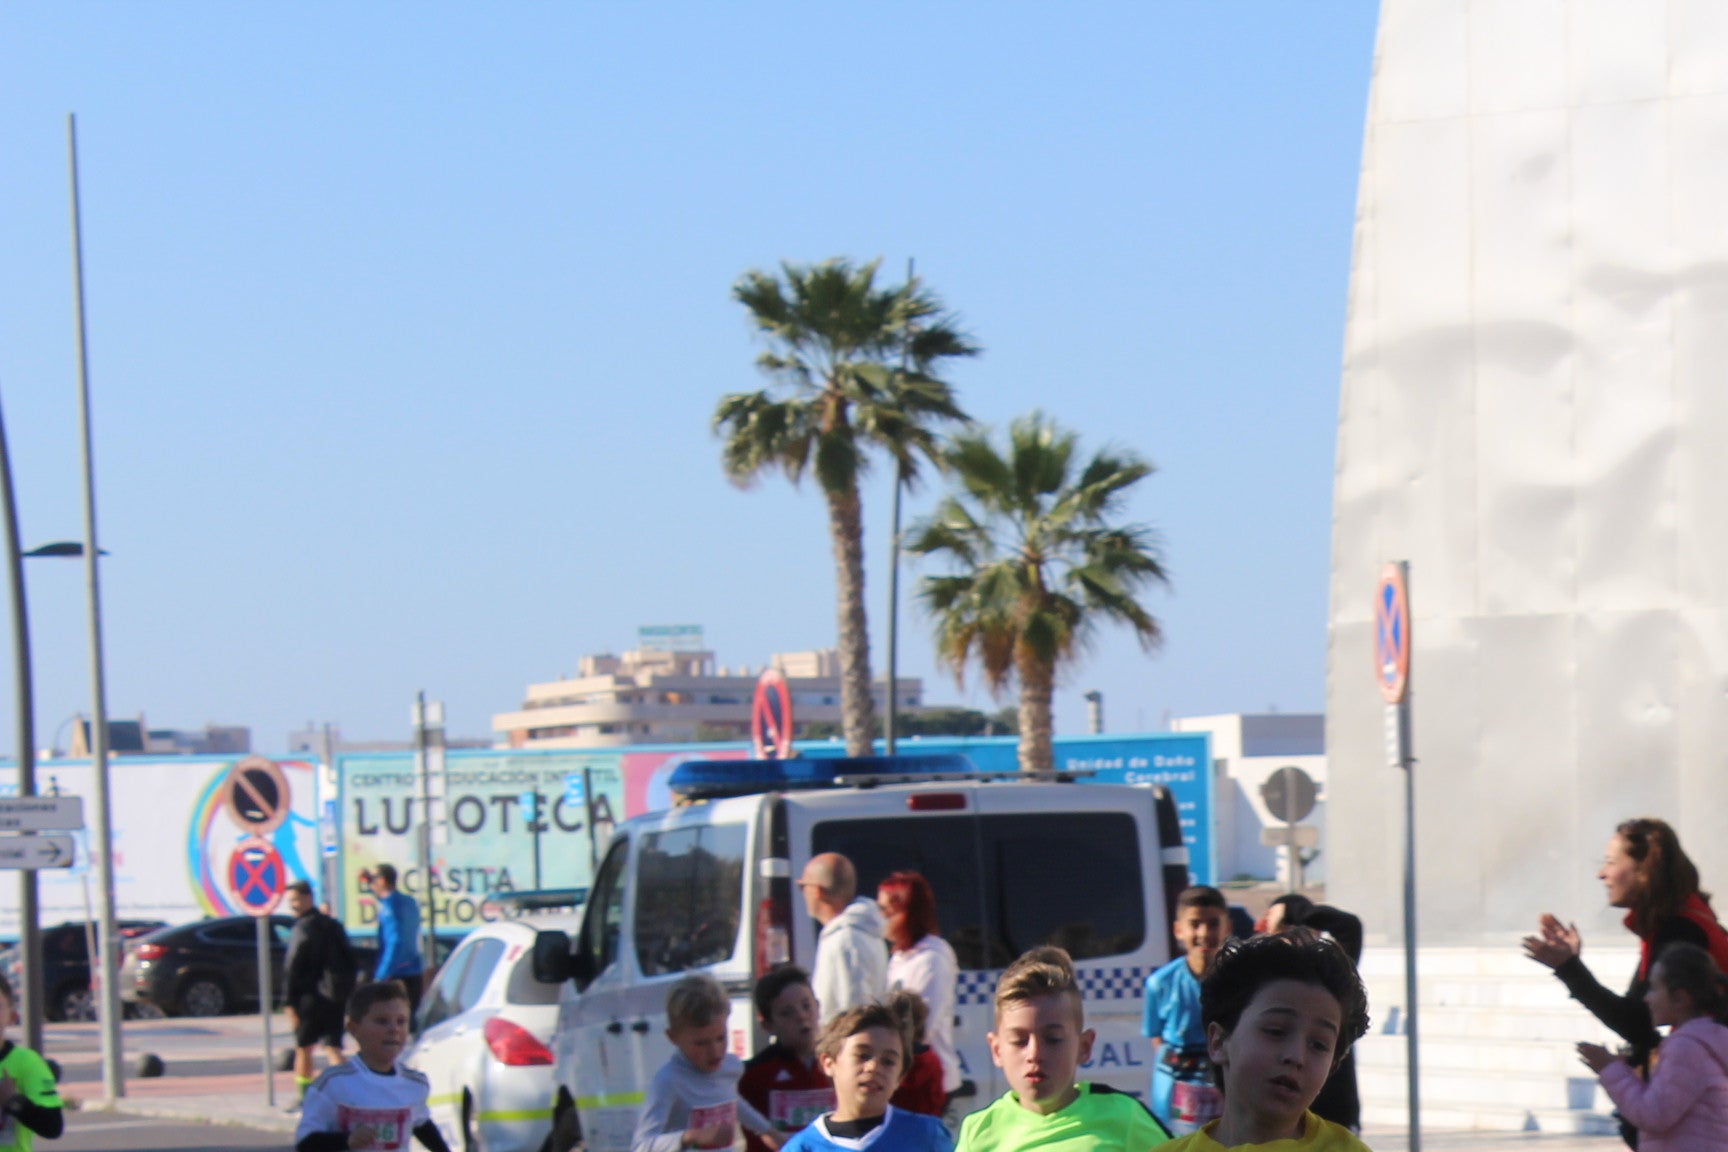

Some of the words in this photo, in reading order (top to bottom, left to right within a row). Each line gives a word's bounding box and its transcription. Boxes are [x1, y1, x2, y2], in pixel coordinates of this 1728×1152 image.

[1129, 756, 1148, 768] de
[1125, 770, 1195, 783] Cerebral
[354, 794, 616, 835] LUOTECA
